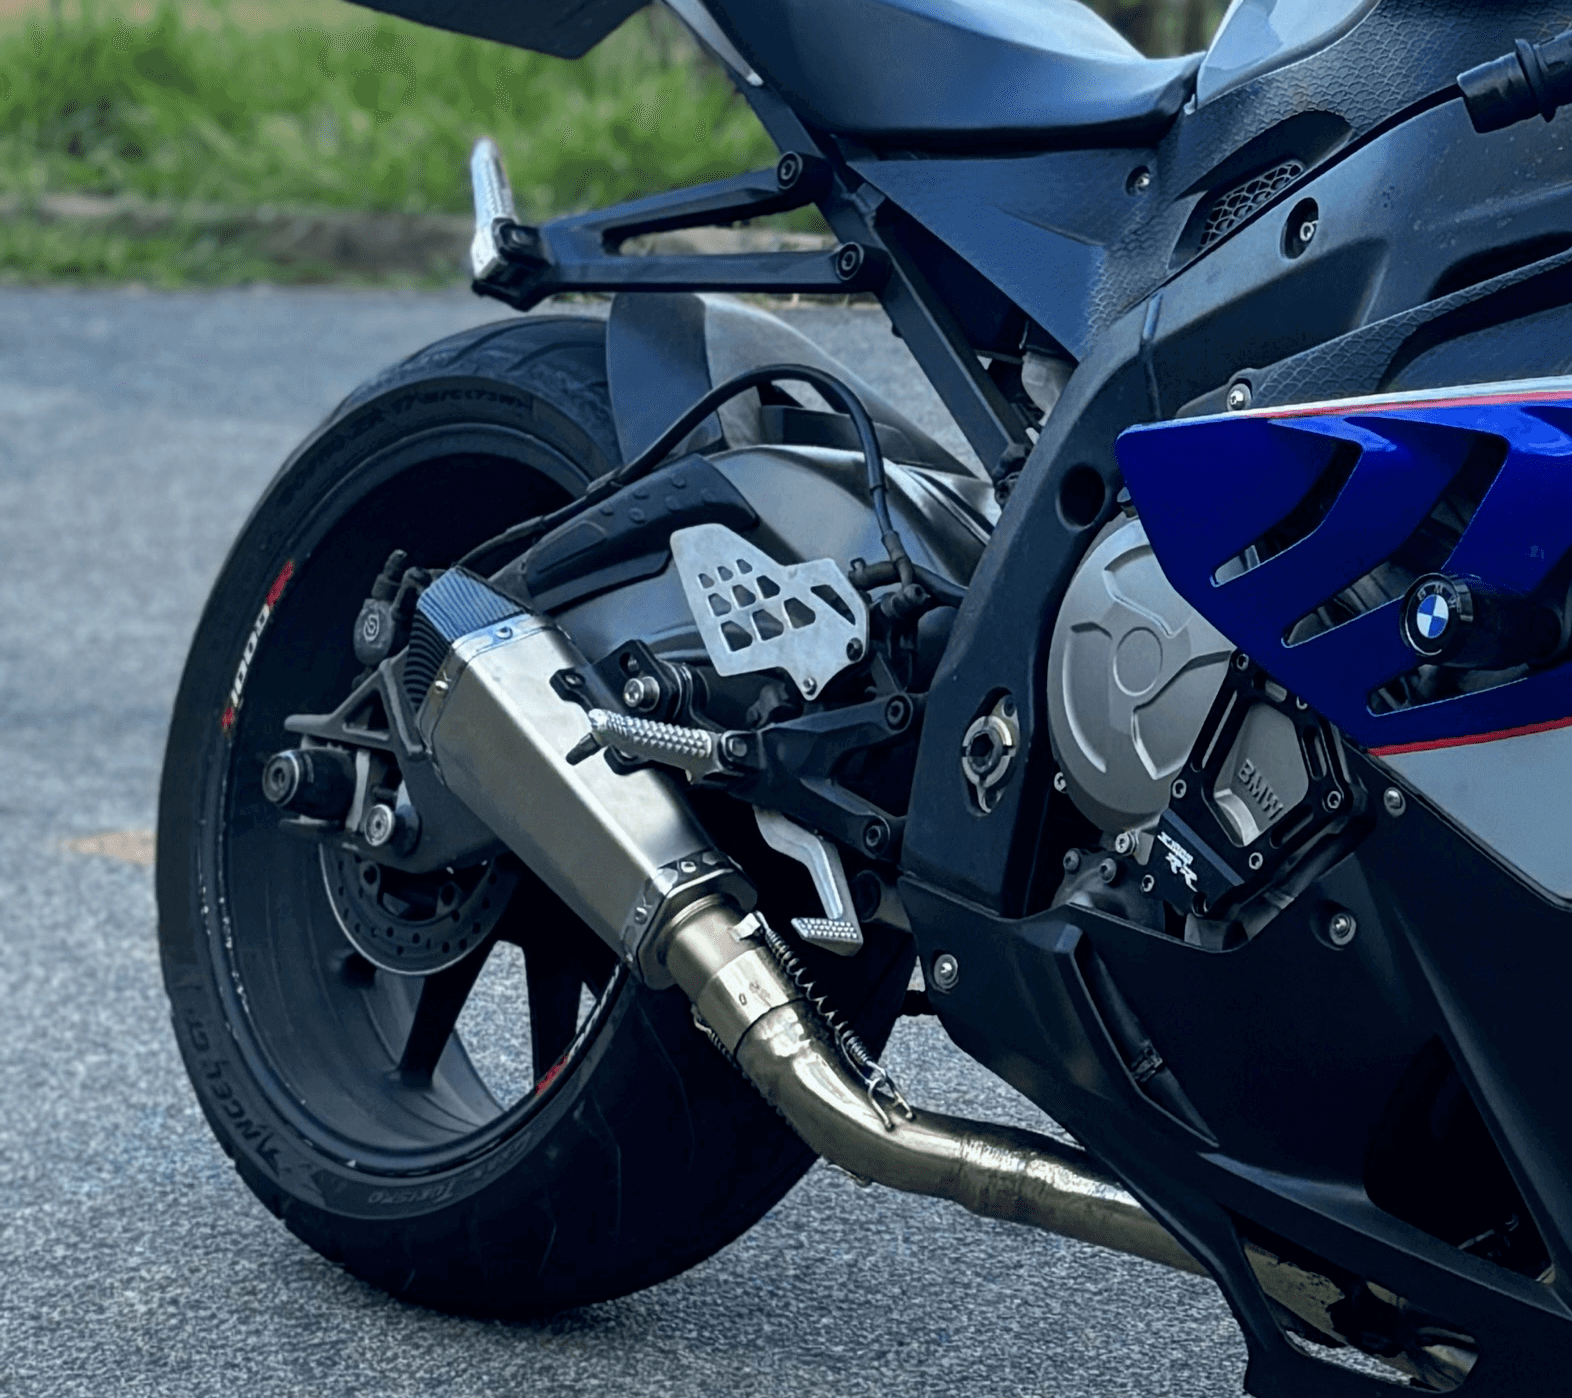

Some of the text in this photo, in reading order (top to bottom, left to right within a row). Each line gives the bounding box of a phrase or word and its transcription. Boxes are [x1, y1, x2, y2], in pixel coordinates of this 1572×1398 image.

[1237, 758, 1284, 819] BMW
[1165, 852, 1198, 893] RR
[205, 1059, 279, 1176] ANGEL
